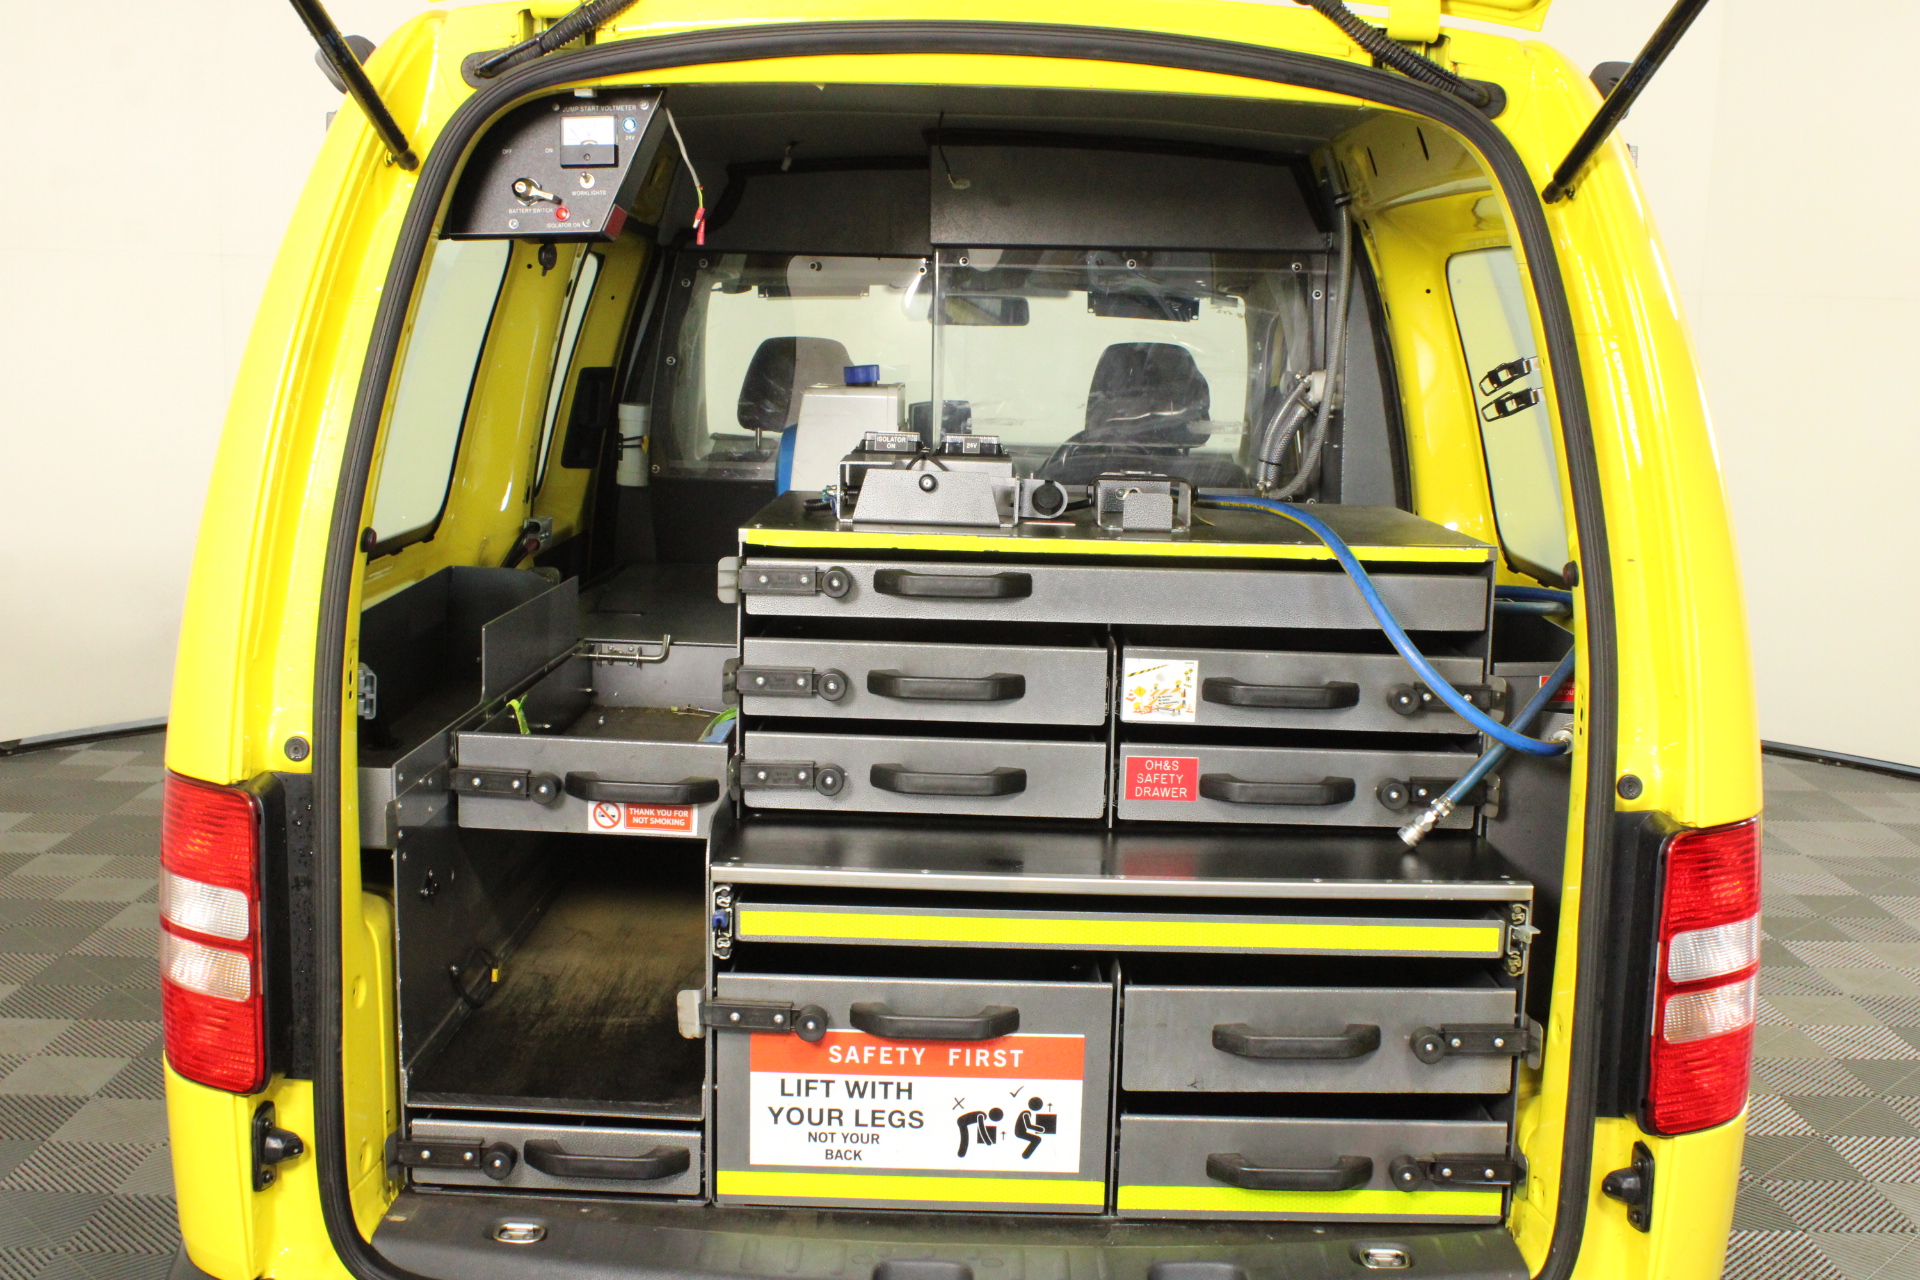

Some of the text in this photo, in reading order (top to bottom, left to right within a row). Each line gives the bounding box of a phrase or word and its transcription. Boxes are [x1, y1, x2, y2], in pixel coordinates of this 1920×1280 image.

[1145, 760, 1179, 771] OH&S
[1137, 773, 1184, 784] SAFETY
[1135, 787, 1187, 798] DRAWER
[650, 818, 685, 826] SMOKING
[828, 1045, 1024, 1068] SAFETY FIRST
[780, 1078, 913, 1100] LIFT WITH
[768, 1106, 924, 1129] YOUR LEGS
[808, 1131, 880, 1144] NOT YOUR
[825, 1150, 862, 1161] BACK
